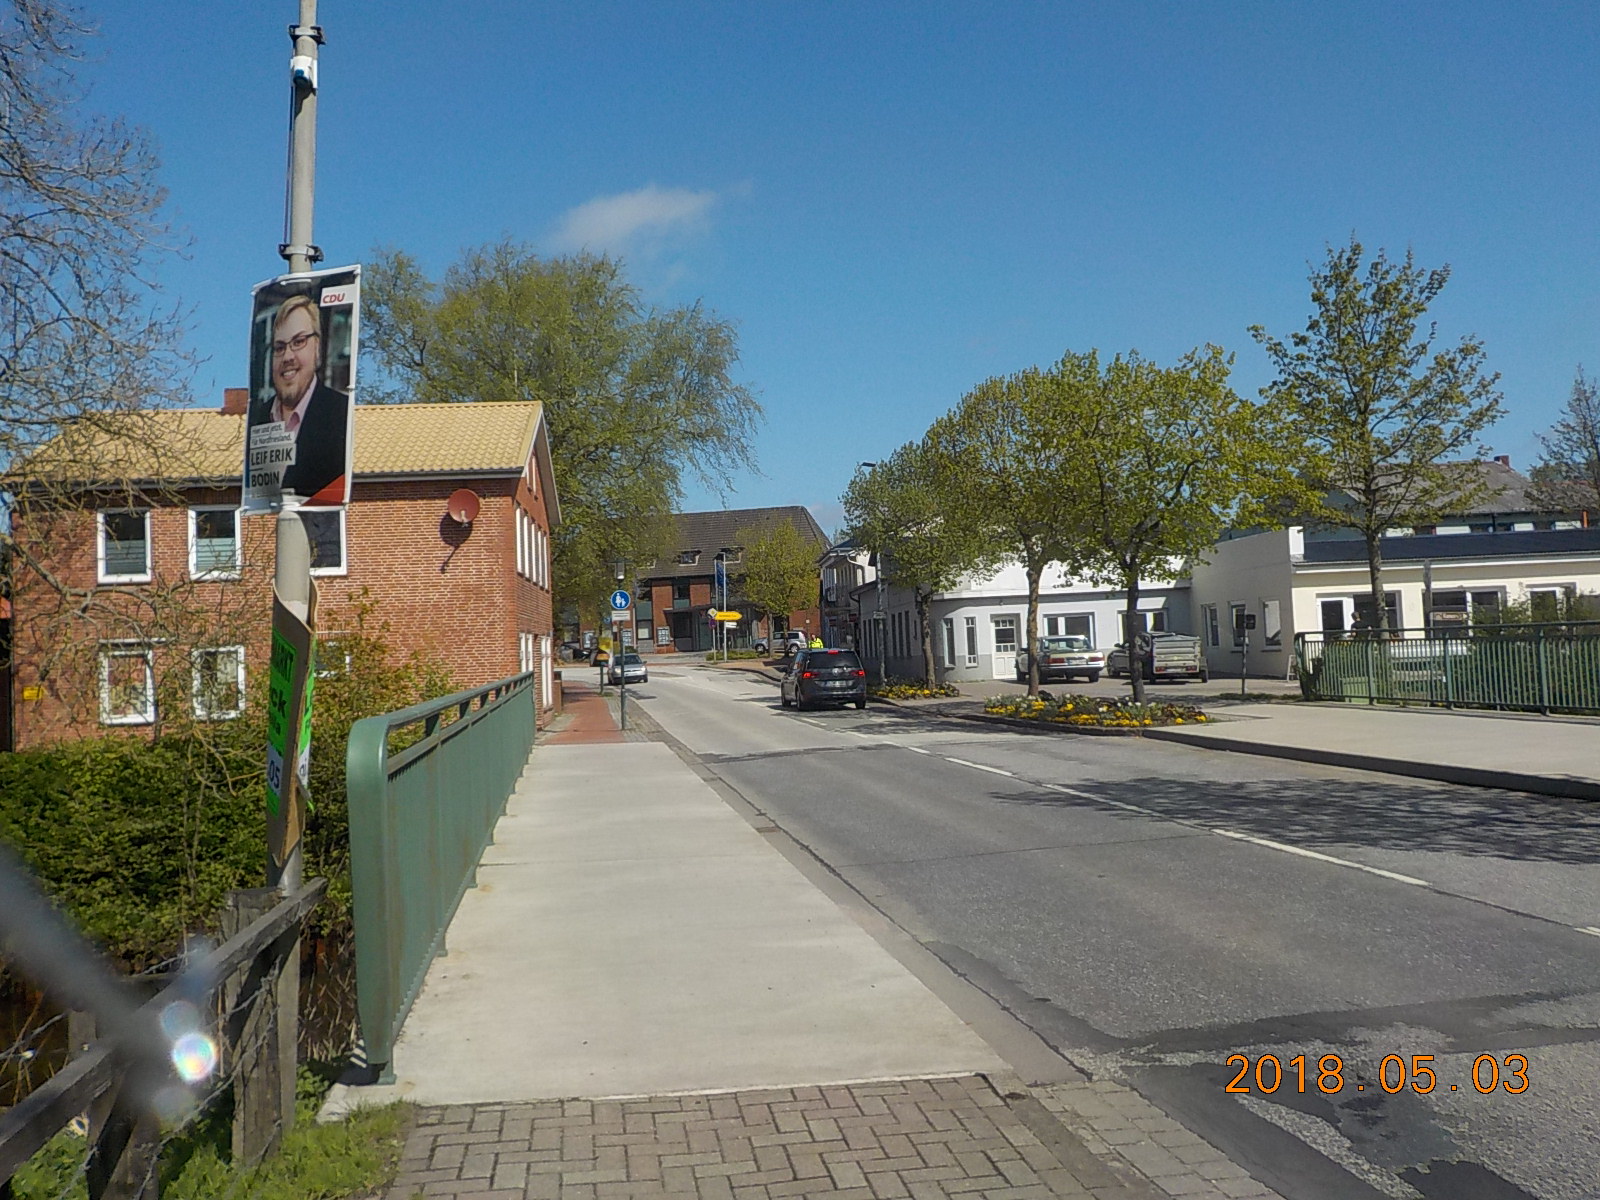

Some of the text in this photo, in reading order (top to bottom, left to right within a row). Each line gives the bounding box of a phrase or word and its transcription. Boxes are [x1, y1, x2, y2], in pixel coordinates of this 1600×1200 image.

[322, 293, 346, 304] CDU
[251, 447, 294, 466] LEIF ERIK
[251, 471, 280, 487] BODIN
